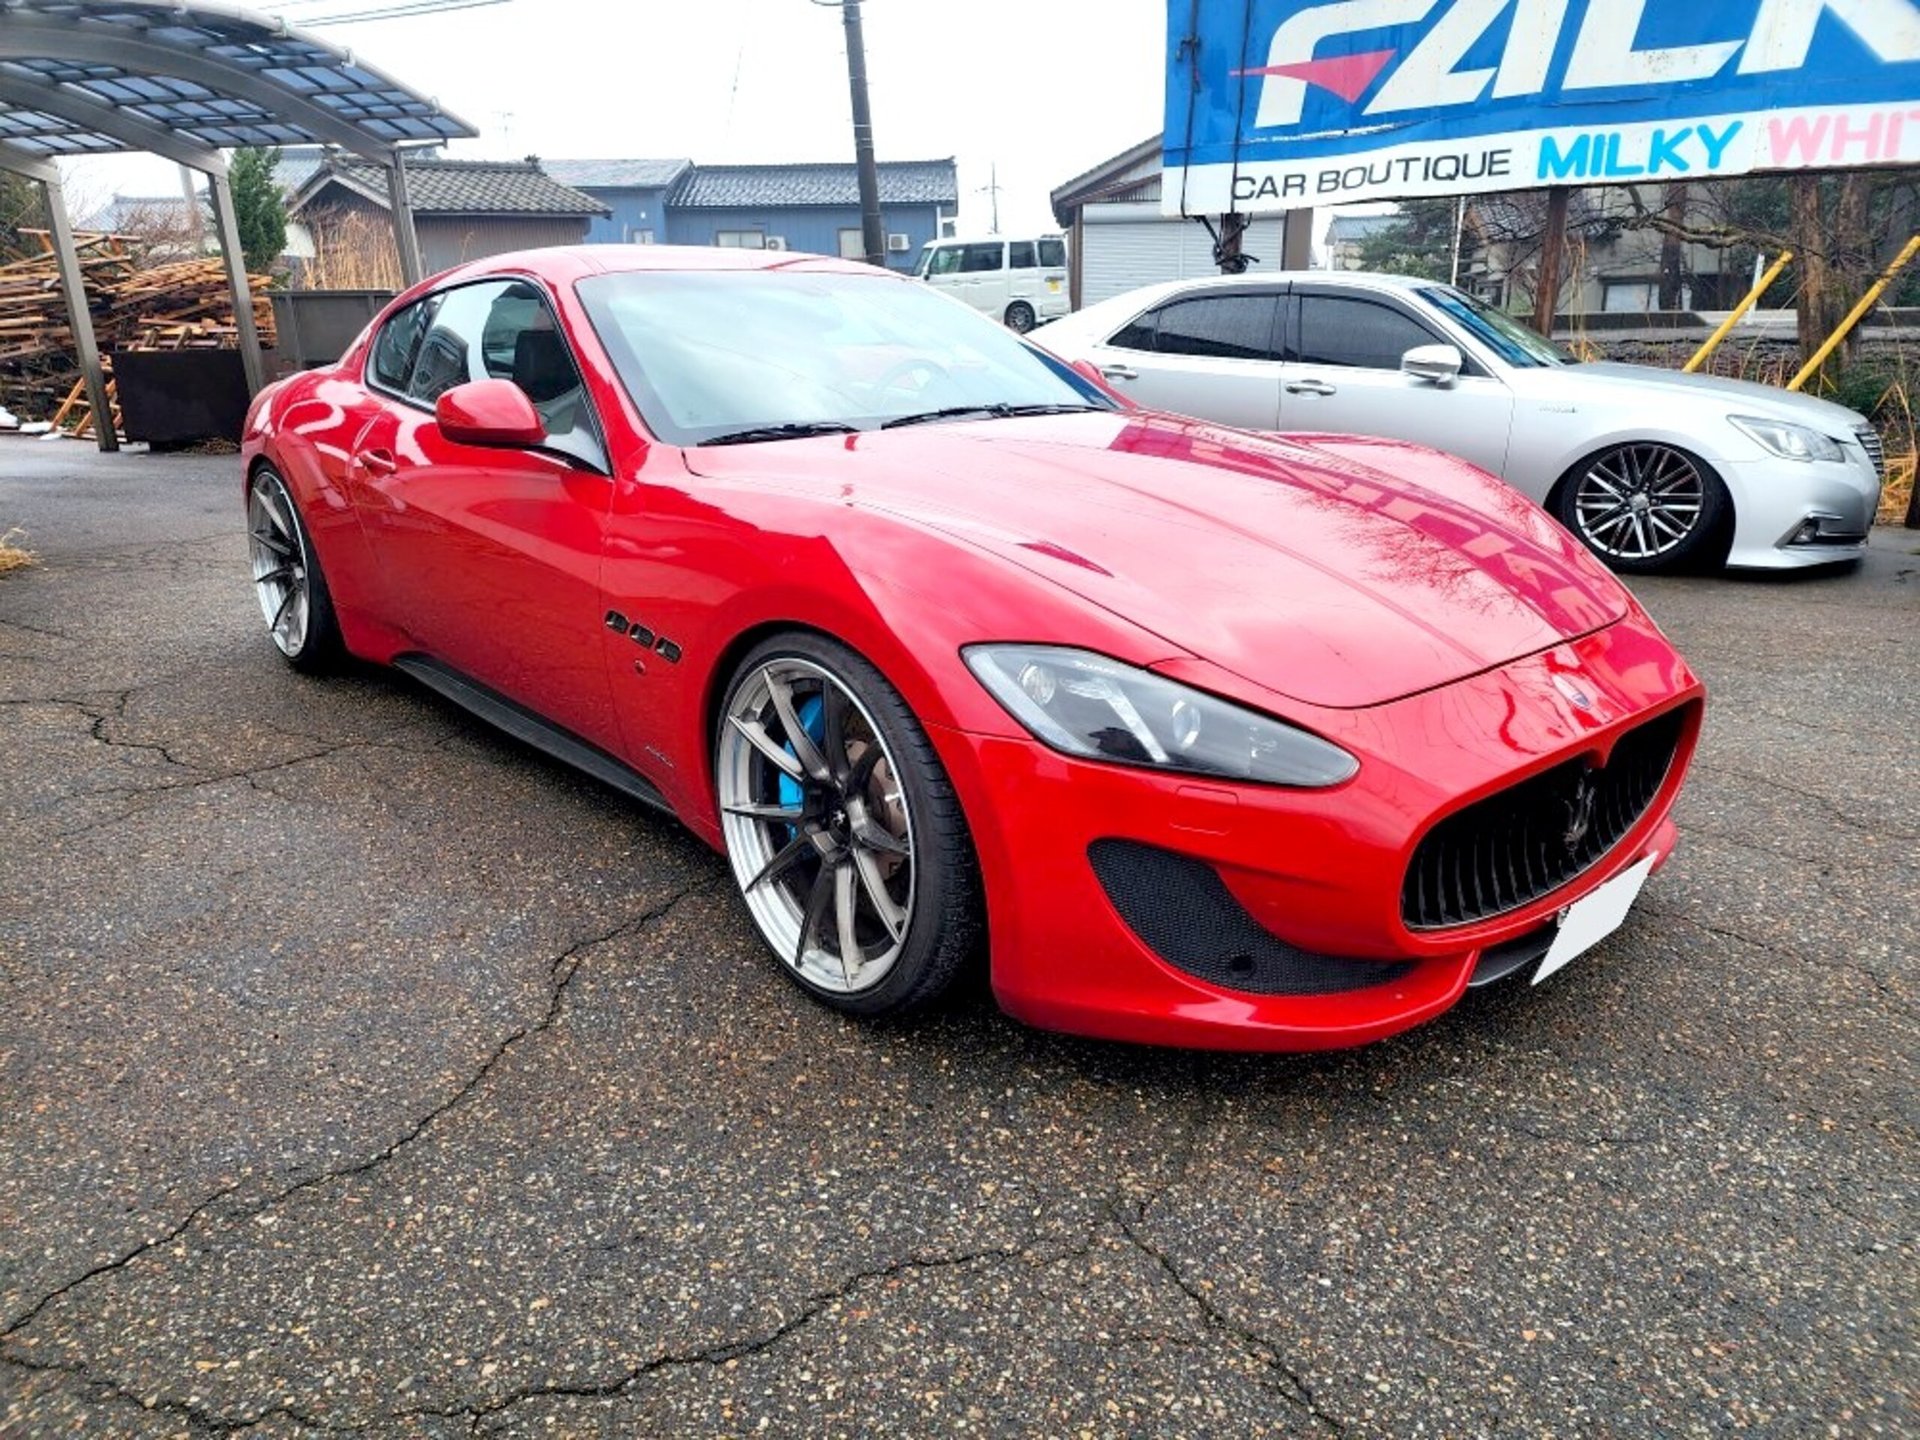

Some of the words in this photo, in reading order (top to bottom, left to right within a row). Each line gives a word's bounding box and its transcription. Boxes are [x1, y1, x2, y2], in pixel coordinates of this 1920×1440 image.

[1231, 174, 1306, 201] CAR
[1316, 148, 1513, 194] BOUTIQUE
[1537, 120, 1744, 179] MILKY
